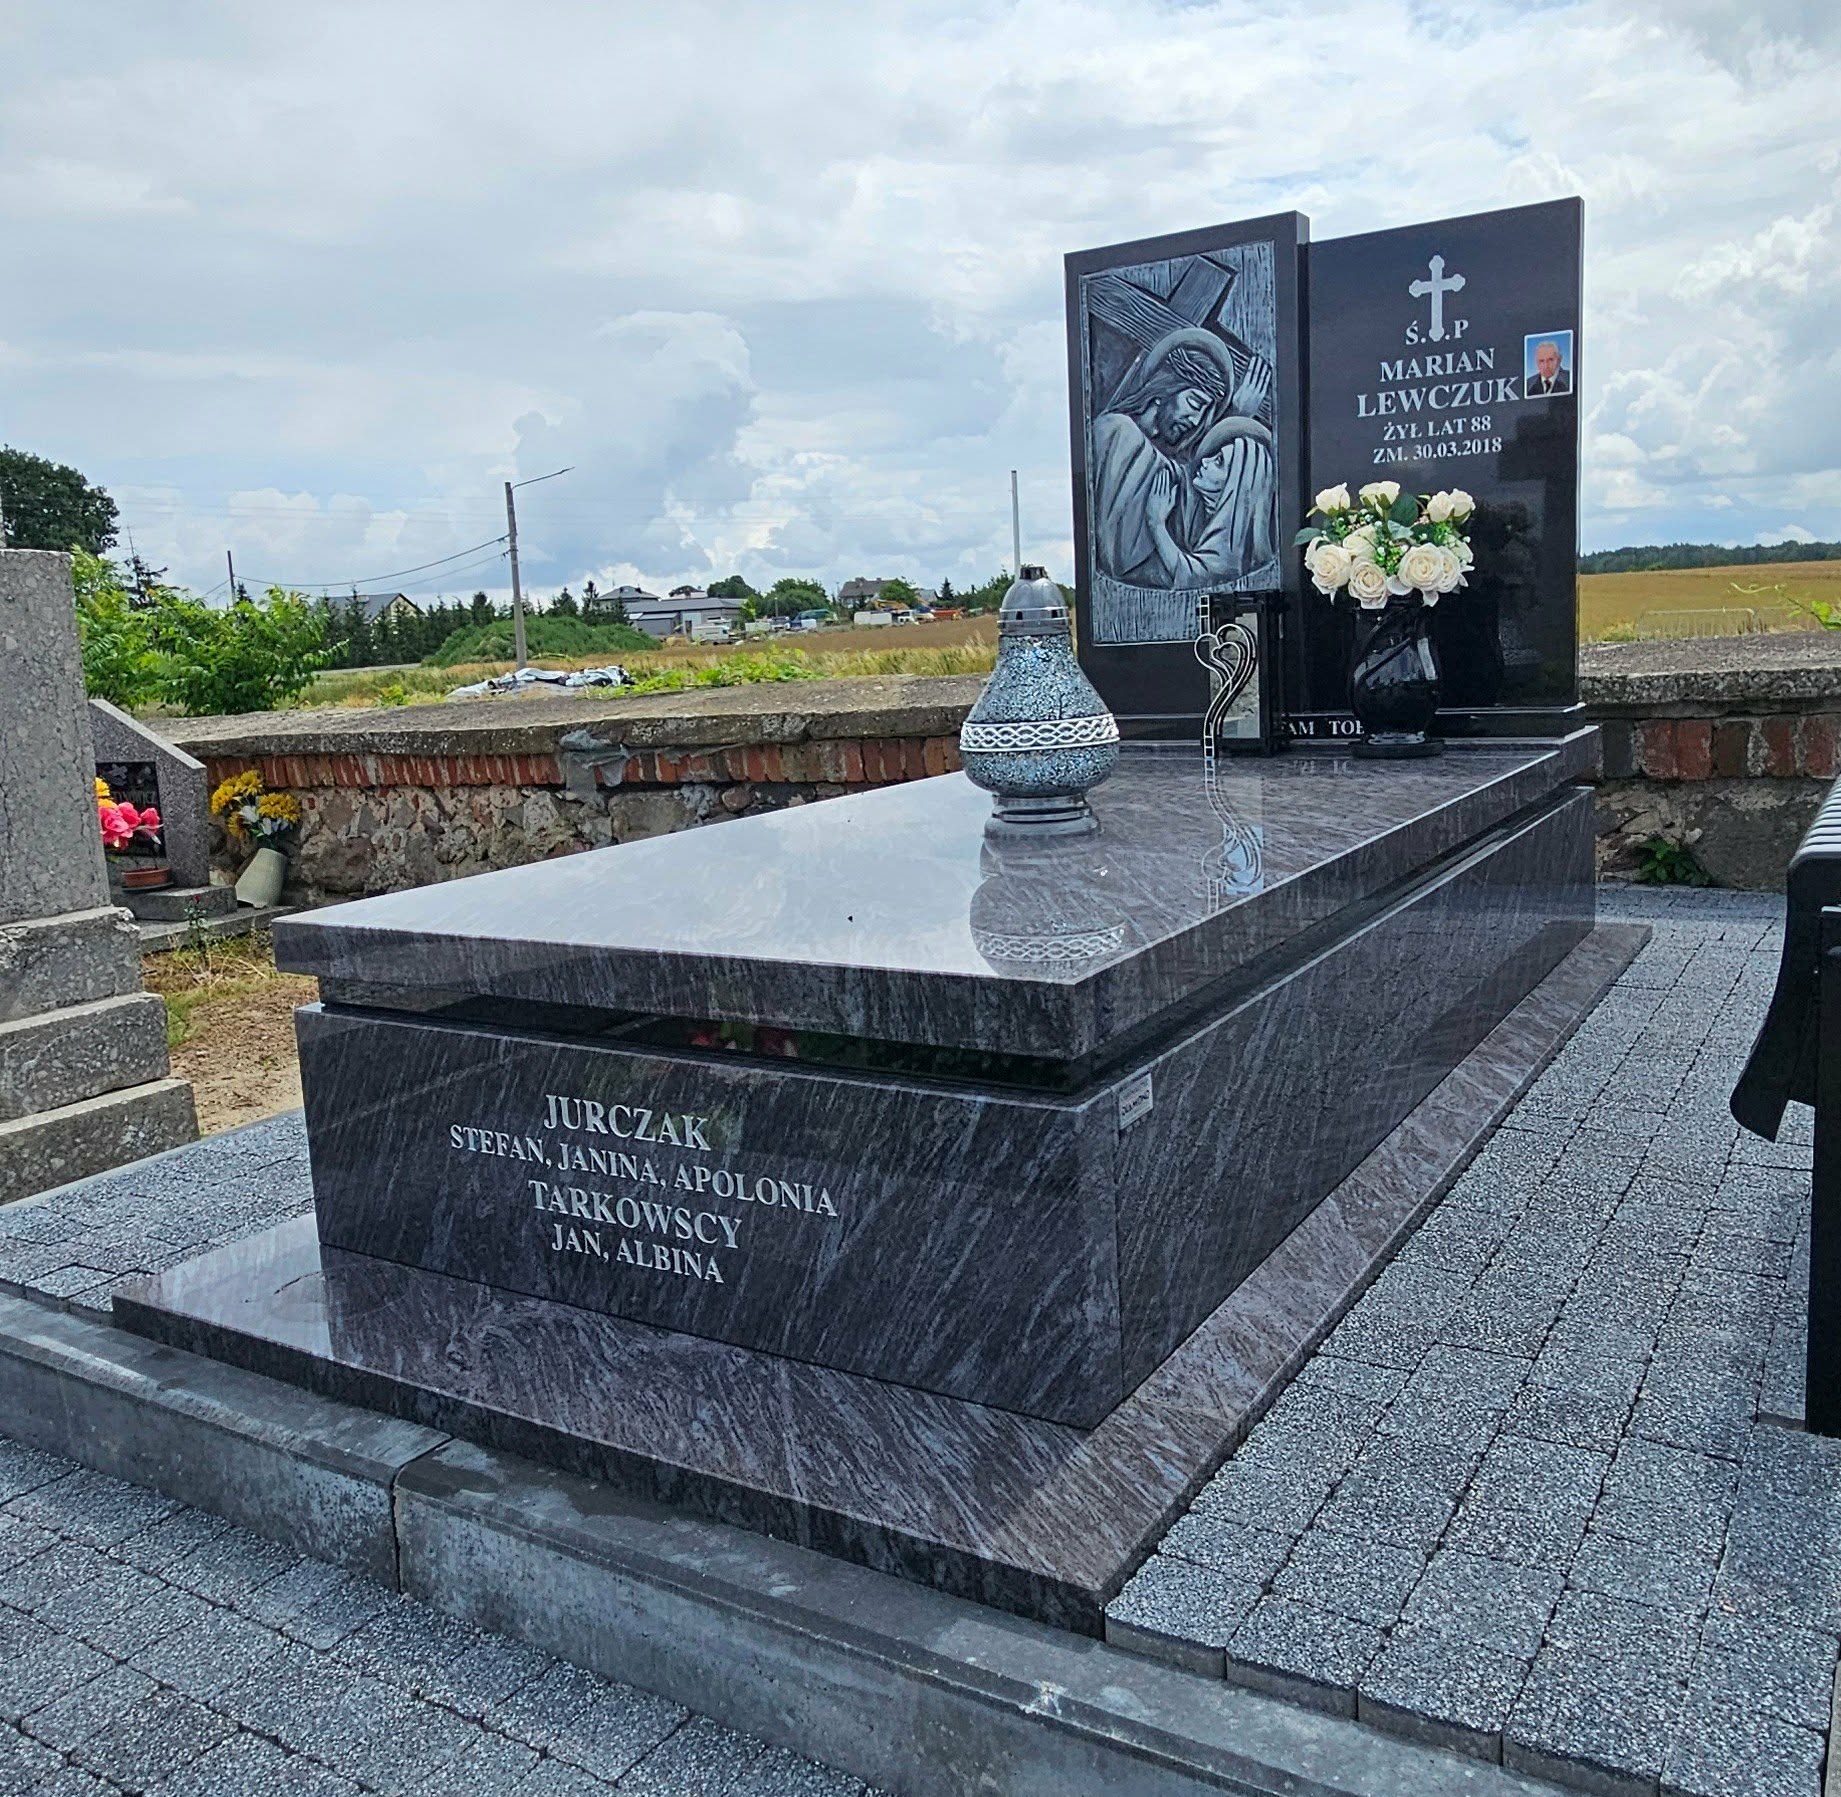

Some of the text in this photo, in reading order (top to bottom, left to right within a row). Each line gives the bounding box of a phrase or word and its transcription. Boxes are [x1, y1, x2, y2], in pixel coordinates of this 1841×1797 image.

[1380, 348, 1495, 382] MARIAN
[1357, 376, 1520, 418] LEWCZUK
[1373, 436, 1502, 464] ZM. 30.03.2018
[1383, 415, 1491, 441] ŻYŁ LAT 88
[543, 1094, 711, 1152] JURCZAK
[450, 1124, 838, 1217] STEFAN, JANINA, APOLONIA
[527, 1180, 742, 1249] TARKOWSCY
[551, 1223, 725, 1284] JAN, ALBINA
